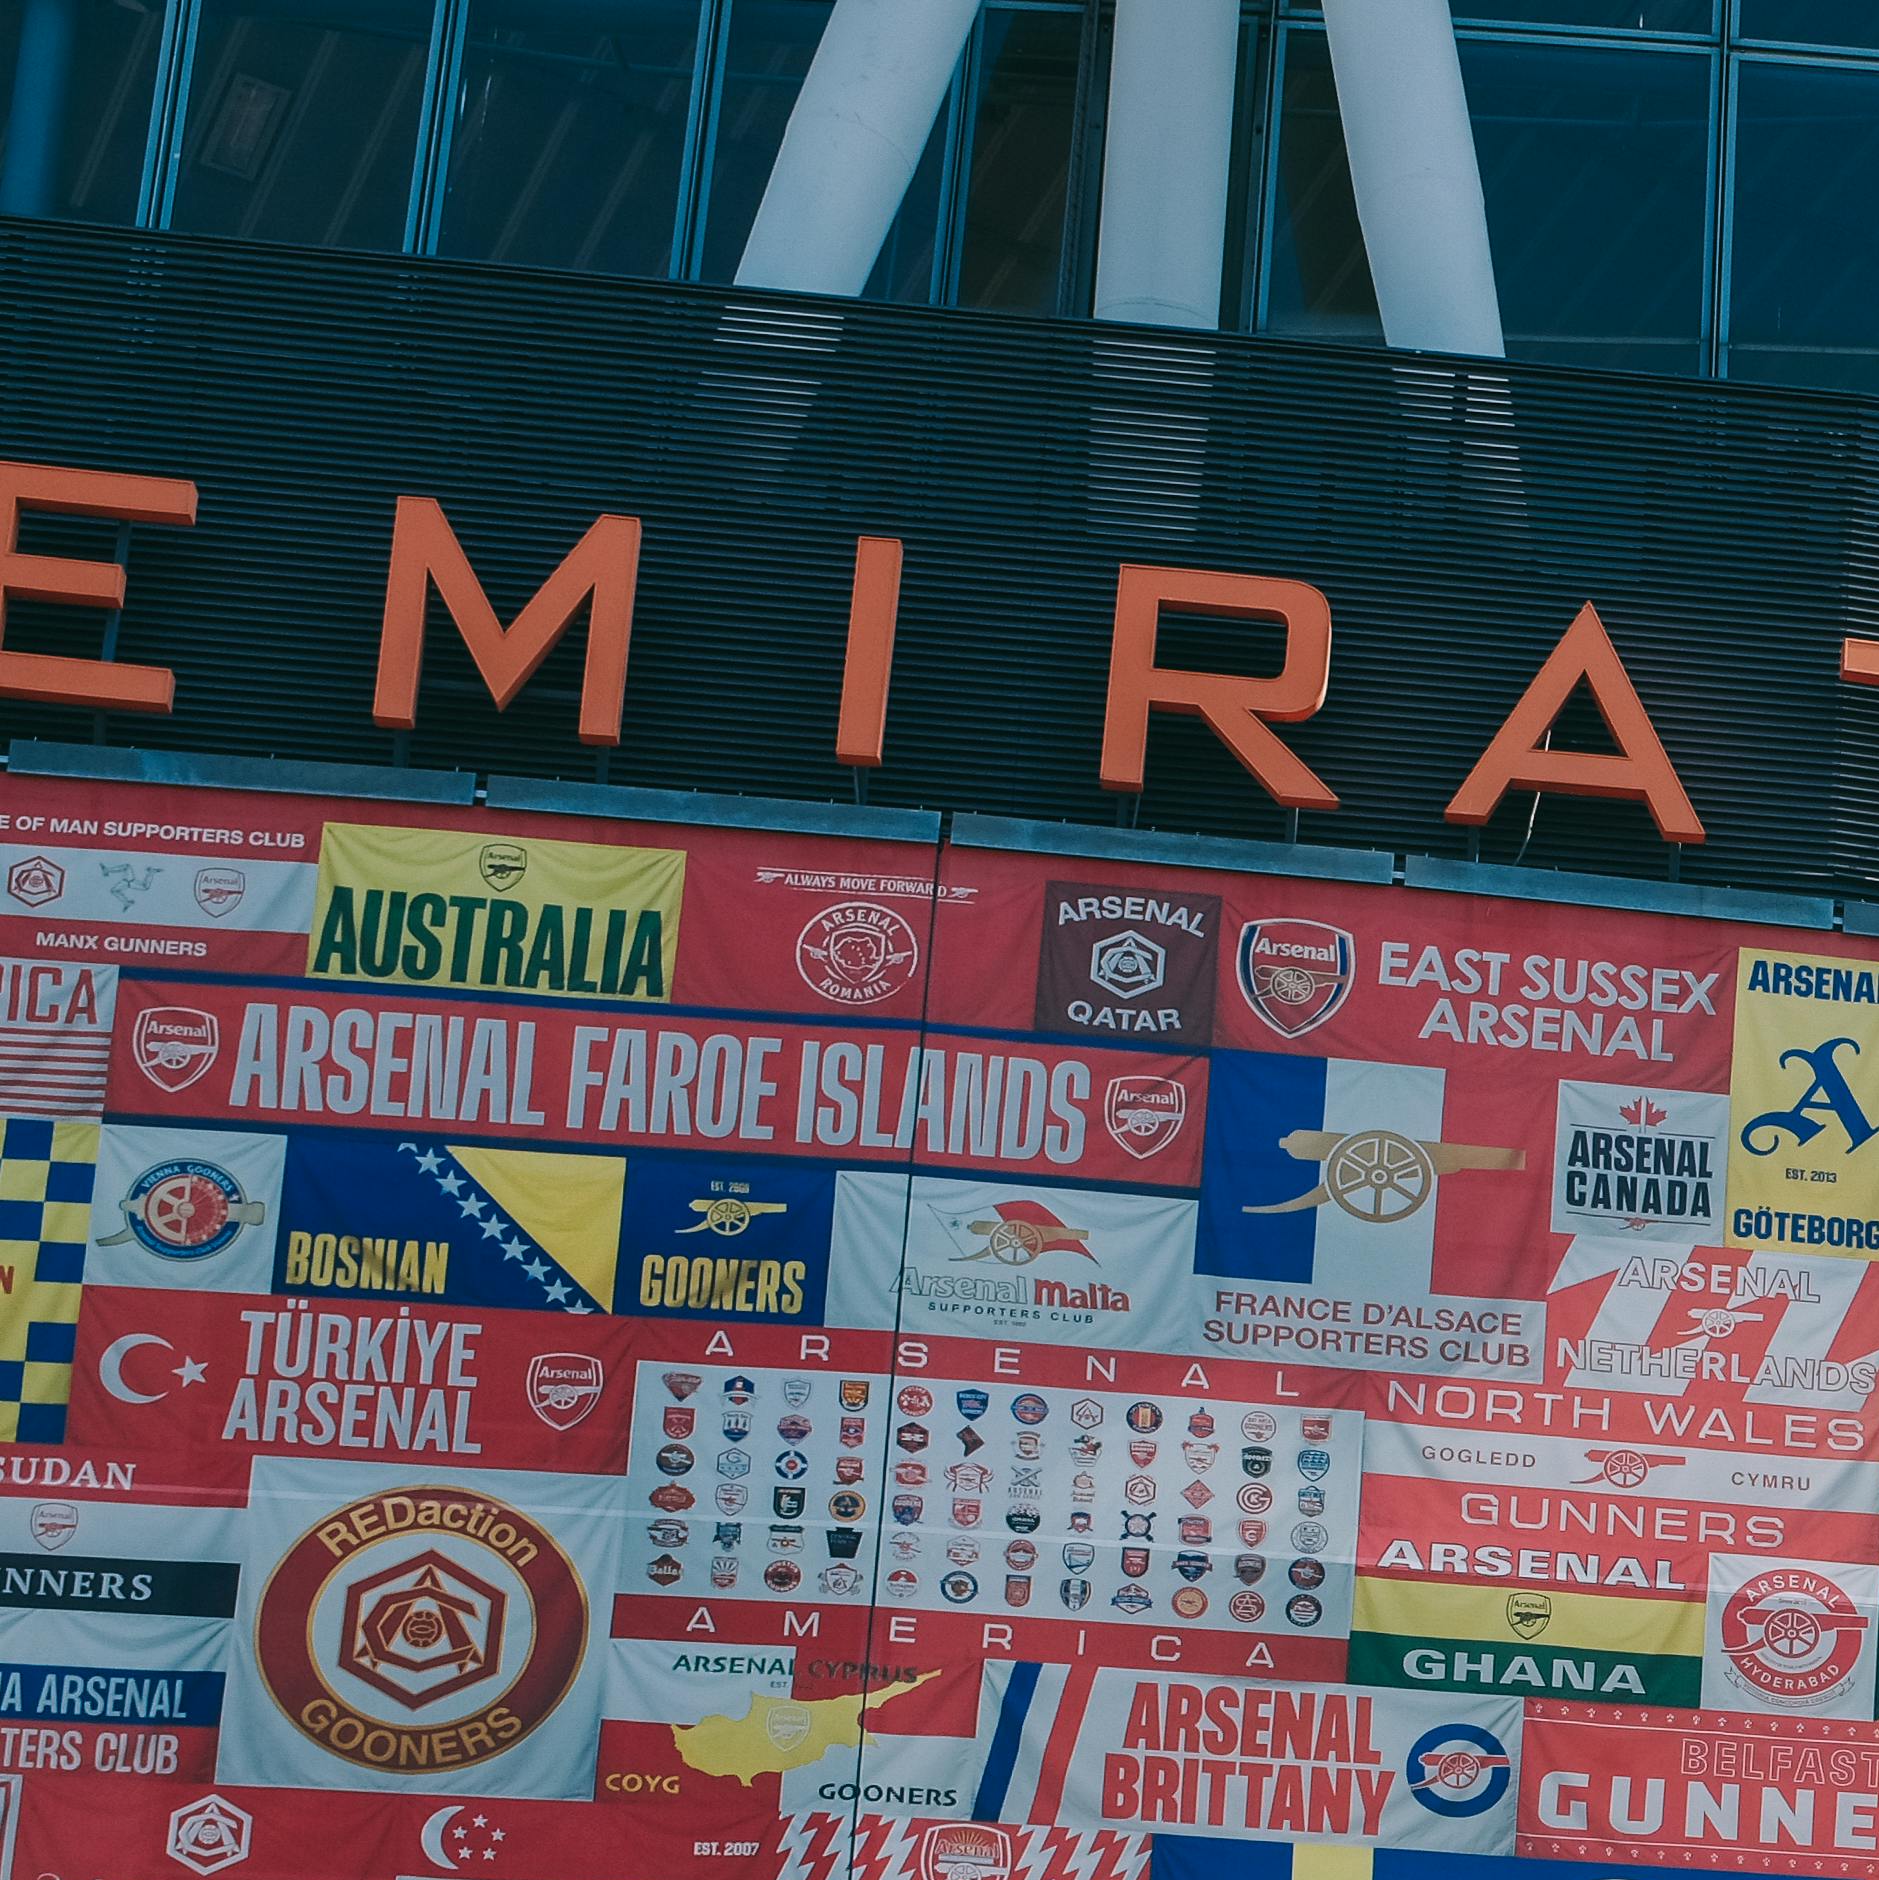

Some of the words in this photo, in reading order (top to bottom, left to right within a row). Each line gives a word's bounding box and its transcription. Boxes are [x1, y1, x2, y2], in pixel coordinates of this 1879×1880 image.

[35, 932, 98, 950] MANX
[104, 936, 207, 955] GUNNERS
[314, 884, 666, 998] AUSTRALIA
[1057, 894, 1204, 937] ARSENAL
[1379, 941, 1510, 996] EAST
[1519, 954, 1717, 1015] SUSSEX
[1067, 1000, 1181, 1032] QATAR
[1418, 997, 1673, 1062] ARSENAL
[229, 1002, 545, 1126] ARSENAL
[567, 1025, 783, 1140] FAROE
[795, 1039, 1091, 1164] ISLANDS
[1569, 1131, 1713, 1179] ARSENAL
[1566, 1170, 1712, 1218] CANADA
[285, 1231, 448, 1295] BOSNIAN
[641, 1255, 804, 1314] GOONERS
[240, 1299, 482, 1388] TÜRKİYE
[222, 1379, 482, 1454] ARSENAL
[318, 1493, 540, 1568] REDaction
[1377, 1539, 1687, 1591] ARSENAL
[1403, 1647, 1646, 1695] GHANA
[300, 1697, 522, 1766] GOONERS
[1125, 1681, 1381, 1766] ARSENAL
[1101, 1751, 1393, 1836] BRITTANY
[693, 1840, 725, 1857] EST.
[727, 1841, 760, 1857] 2007
